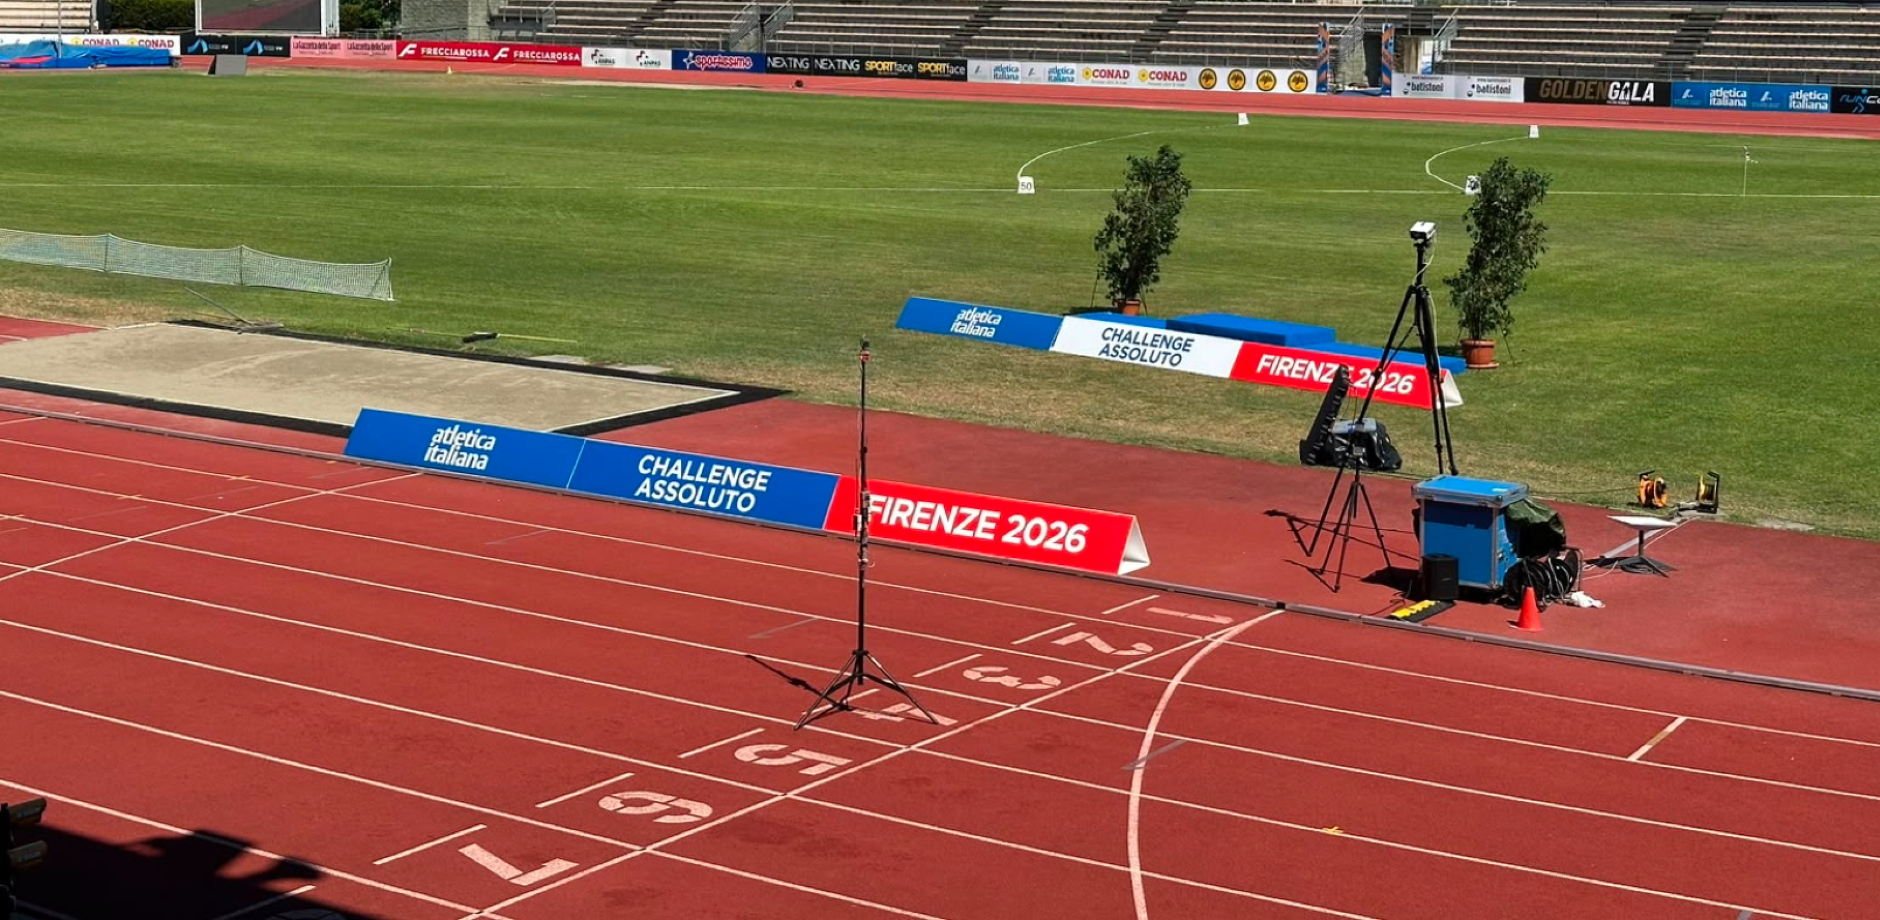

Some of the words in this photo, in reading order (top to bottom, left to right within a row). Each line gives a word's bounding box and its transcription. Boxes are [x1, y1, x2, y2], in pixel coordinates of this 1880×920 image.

[138, 39, 174, 48] CONAD
[421, 47, 490, 57] FRECCIAROSSA
[513, 50, 580, 60] FRECCIAROSSA
[694, 54, 753, 71] sportissimo
[767, 57, 810, 69] NEXTING
[814, 58, 860, 71] NEXTING
[993, 64, 1020, 74] atletica
[993, 71, 1020, 80] italiana
[1048, 66, 1075, 75] atletica
[1048, 73, 1075, 82] italiana
[1092, 69, 1130, 79] CONAD
[1149, 71, 1187, 81] CONAD
[1709, 87, 1747, 98] atletica
[1789, 90, 1828, 101] atletica
[1709, 97, 1747, 107] italiana
[1789, 99, 1828, 110] italiana
[1021, 182, 1032, 191] 50
[956, 306, 1001, 325] atletica
[950, 321, 995, 338] italiana
[1102, 327, 1194, 353] CHALLENGE
[1099, 343, 1182, 367] ASSOLUTO
[1353, 367, 1416, 395] 2026
[431, 424, 497, 451] atletica
[424, 443, 489, 470] italiana
[638, 455, 772, 492] CHALLENGE
[634, 478, 756, 513] ASSOLUTO
[868, 493, 1001, 540] FIRENZE
[1002, 515, 1088, 553] 2026
[1051, 631, 1154, 656] 2
[963, 666, 1061, 690] 3
[734, 743, 853, 776] 5
[598, 791, 713, 823] 6
[458, 843, 579, 886] 7
